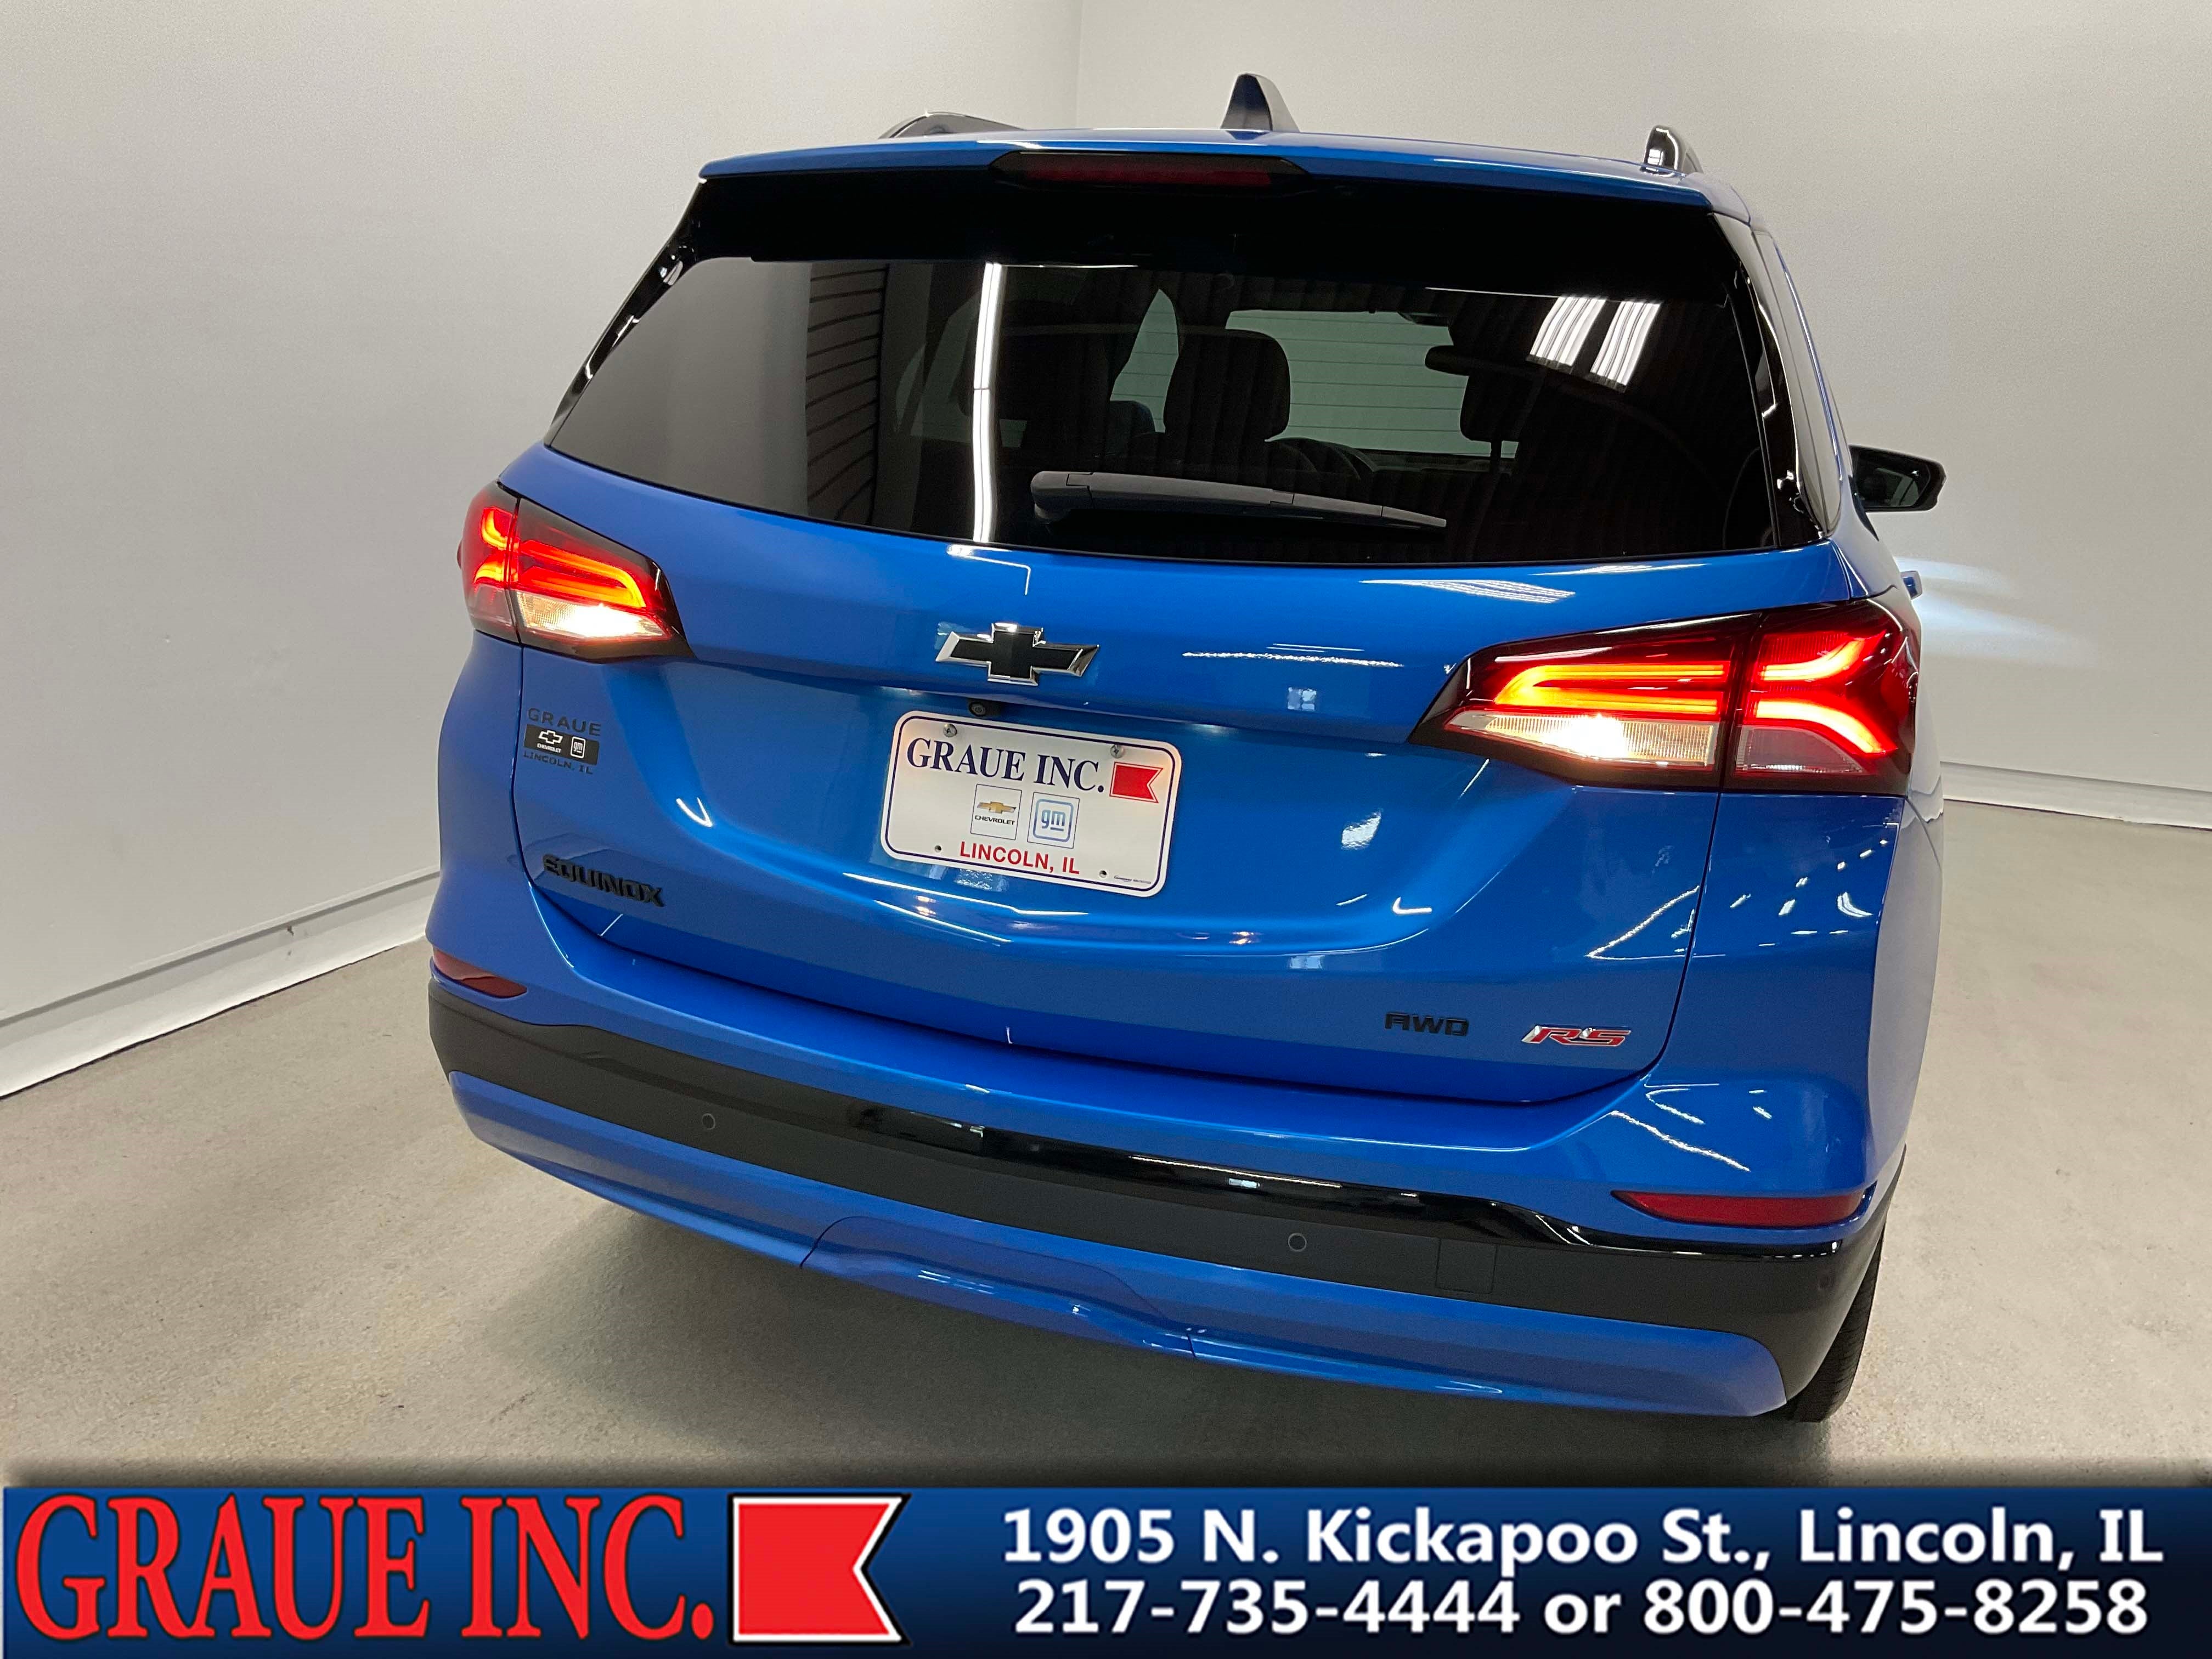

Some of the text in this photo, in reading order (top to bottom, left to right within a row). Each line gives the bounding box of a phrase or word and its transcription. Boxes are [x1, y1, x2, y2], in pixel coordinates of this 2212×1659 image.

[528, 708, 602, 736] GRAUE
[537, 743, 562, 753] CHEVROLET
[579, 764, 593, 775] IL
[907, 737, 1104, 793] GRAUE INC.
[974, 815, 1015, 826] CHEVROLET
[960, 841, 1080, 874] LINCOLN, IL
[543, 854, 664, 907] EQUINOX
[1385, 1012, 1469, 1036] AWD
[1521, 1024, 1632, 1047] RS
